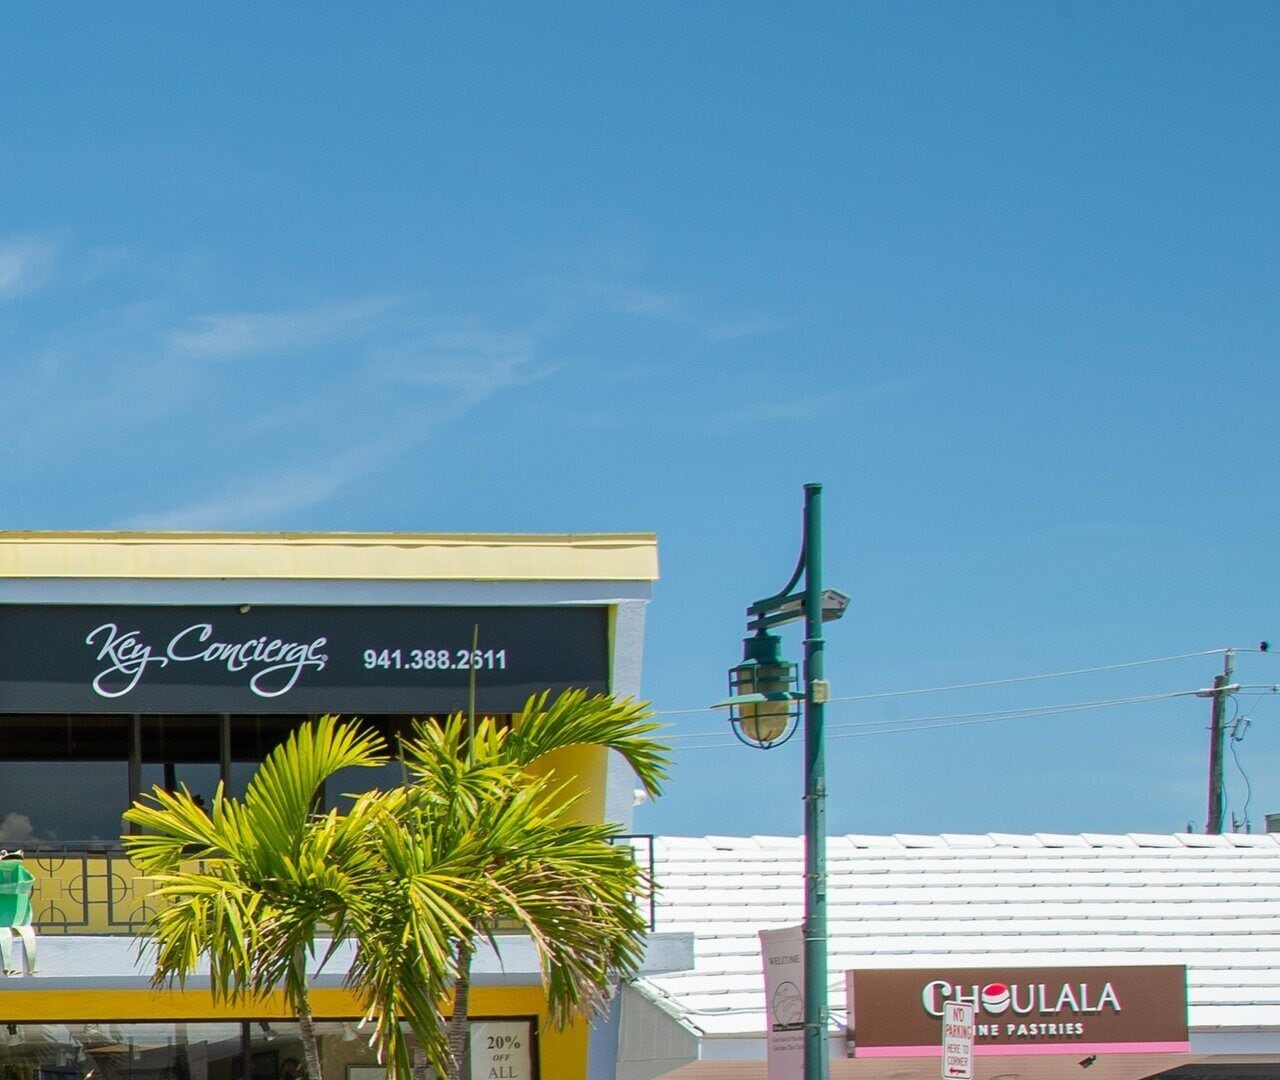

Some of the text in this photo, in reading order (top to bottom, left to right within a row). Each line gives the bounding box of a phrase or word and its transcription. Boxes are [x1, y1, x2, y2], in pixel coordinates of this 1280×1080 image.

[85, 622, 169, 699] Key
[363, 648, 507, 671] 941.388.2611
[922, 979, 1122, 1017] CHOULALA
[952, 1007, 965, 1022] NO
[945, 1024, 973, 1039] PARKING
[1007, 1022, 1084, 1036] PASTRIES
[487, 1035, 521, 1050] 20%
[493, 1054, 511, 1062] OFF
[488, 1066, 518, 1079] ALL
